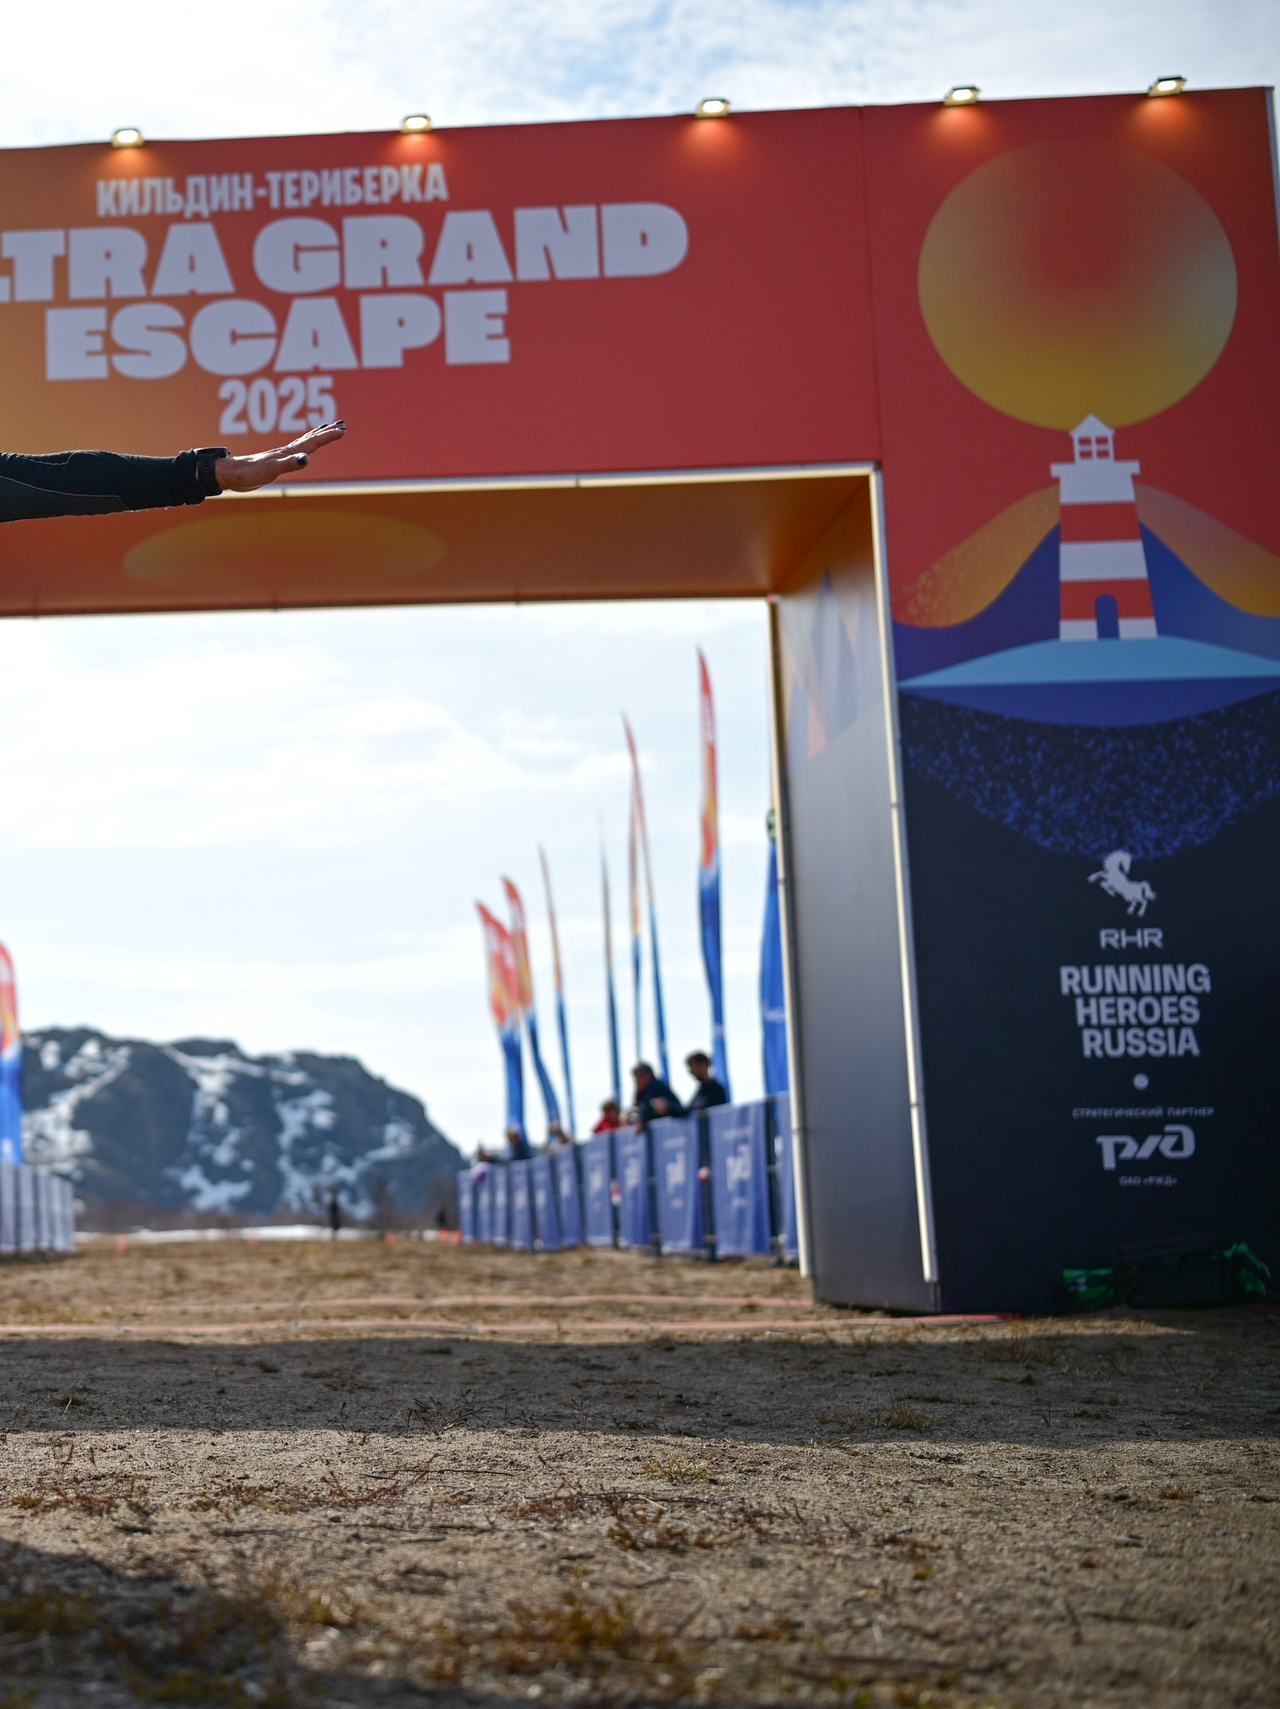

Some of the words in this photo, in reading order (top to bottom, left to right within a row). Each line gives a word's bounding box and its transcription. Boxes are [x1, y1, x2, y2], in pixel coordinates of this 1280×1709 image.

[96, 163, 449, 220] КИЛЬДИН-ТЕРИБЕРКА
[252, 202, 689, 294] GRAND
[45, 288, 511, 380] ESCAPE
[217, 375, 337, 435] 2025
[1100, 928, 1163, 949] RHR
[1060, 963, 1212, 996] RUNNING
[1075, 995, 1201, 1027] HEROES
[1082, 1027, 1200, 1058] RUSSIA
[1072, 1105, 1163, 1119] СТРАТЕГИЧЕСКИЙ
[1167, 1106, 1215, 1118] ПАРТНЕР
